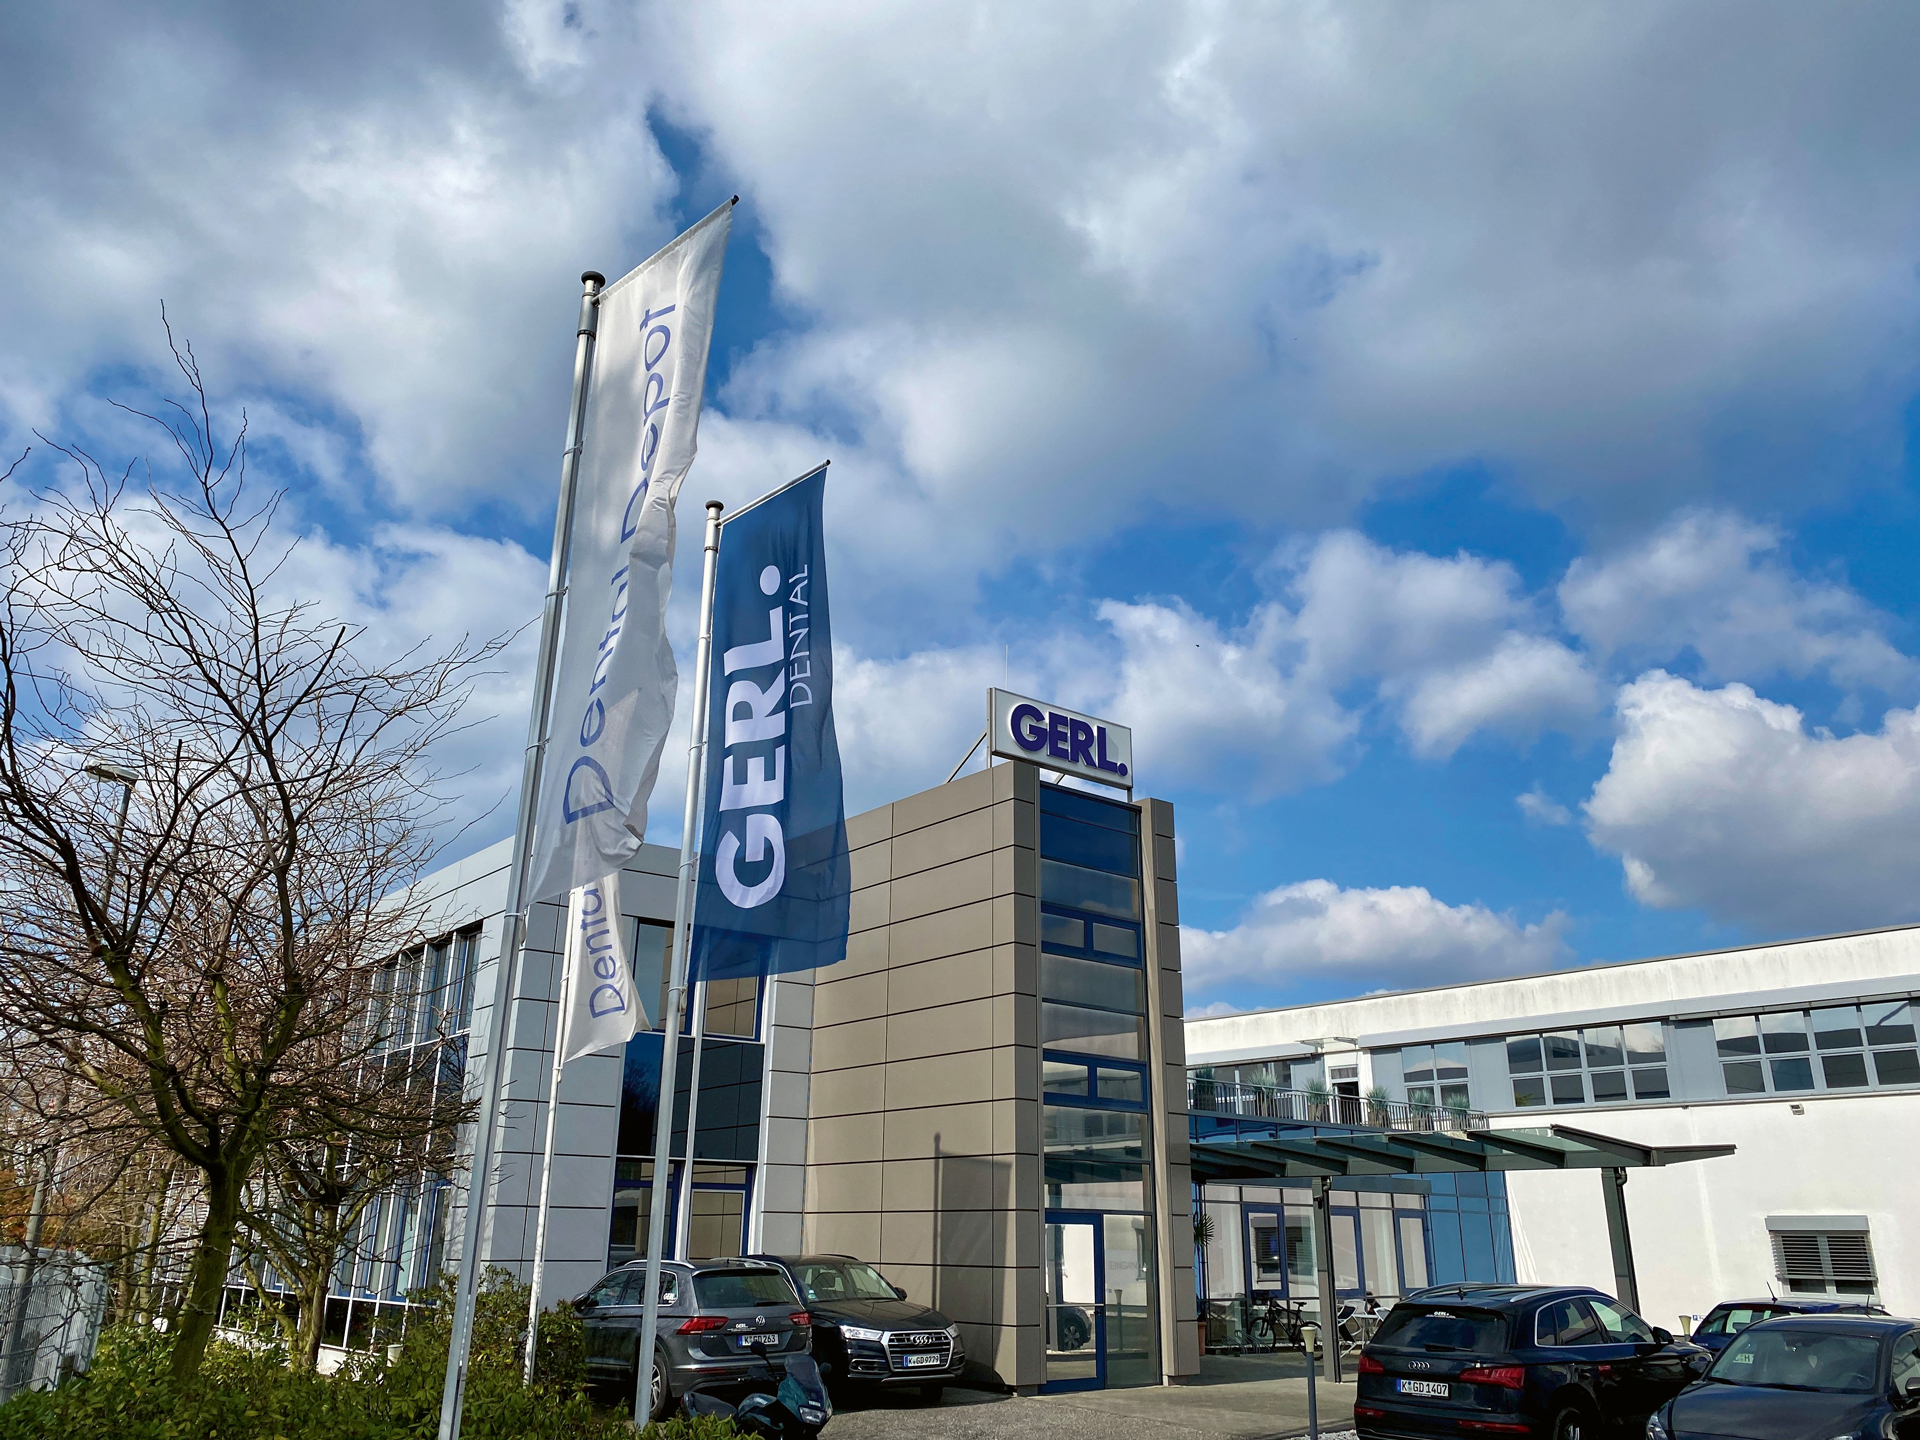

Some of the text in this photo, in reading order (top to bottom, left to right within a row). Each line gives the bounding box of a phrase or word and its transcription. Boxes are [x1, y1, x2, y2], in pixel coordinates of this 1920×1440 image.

[788, 564, 813, 709] DENTAL
[715, 565, 786, 909] GERL.
[1010, 703, 1129, 777] GERL.
[580, 886, 625, 1018] Denta
